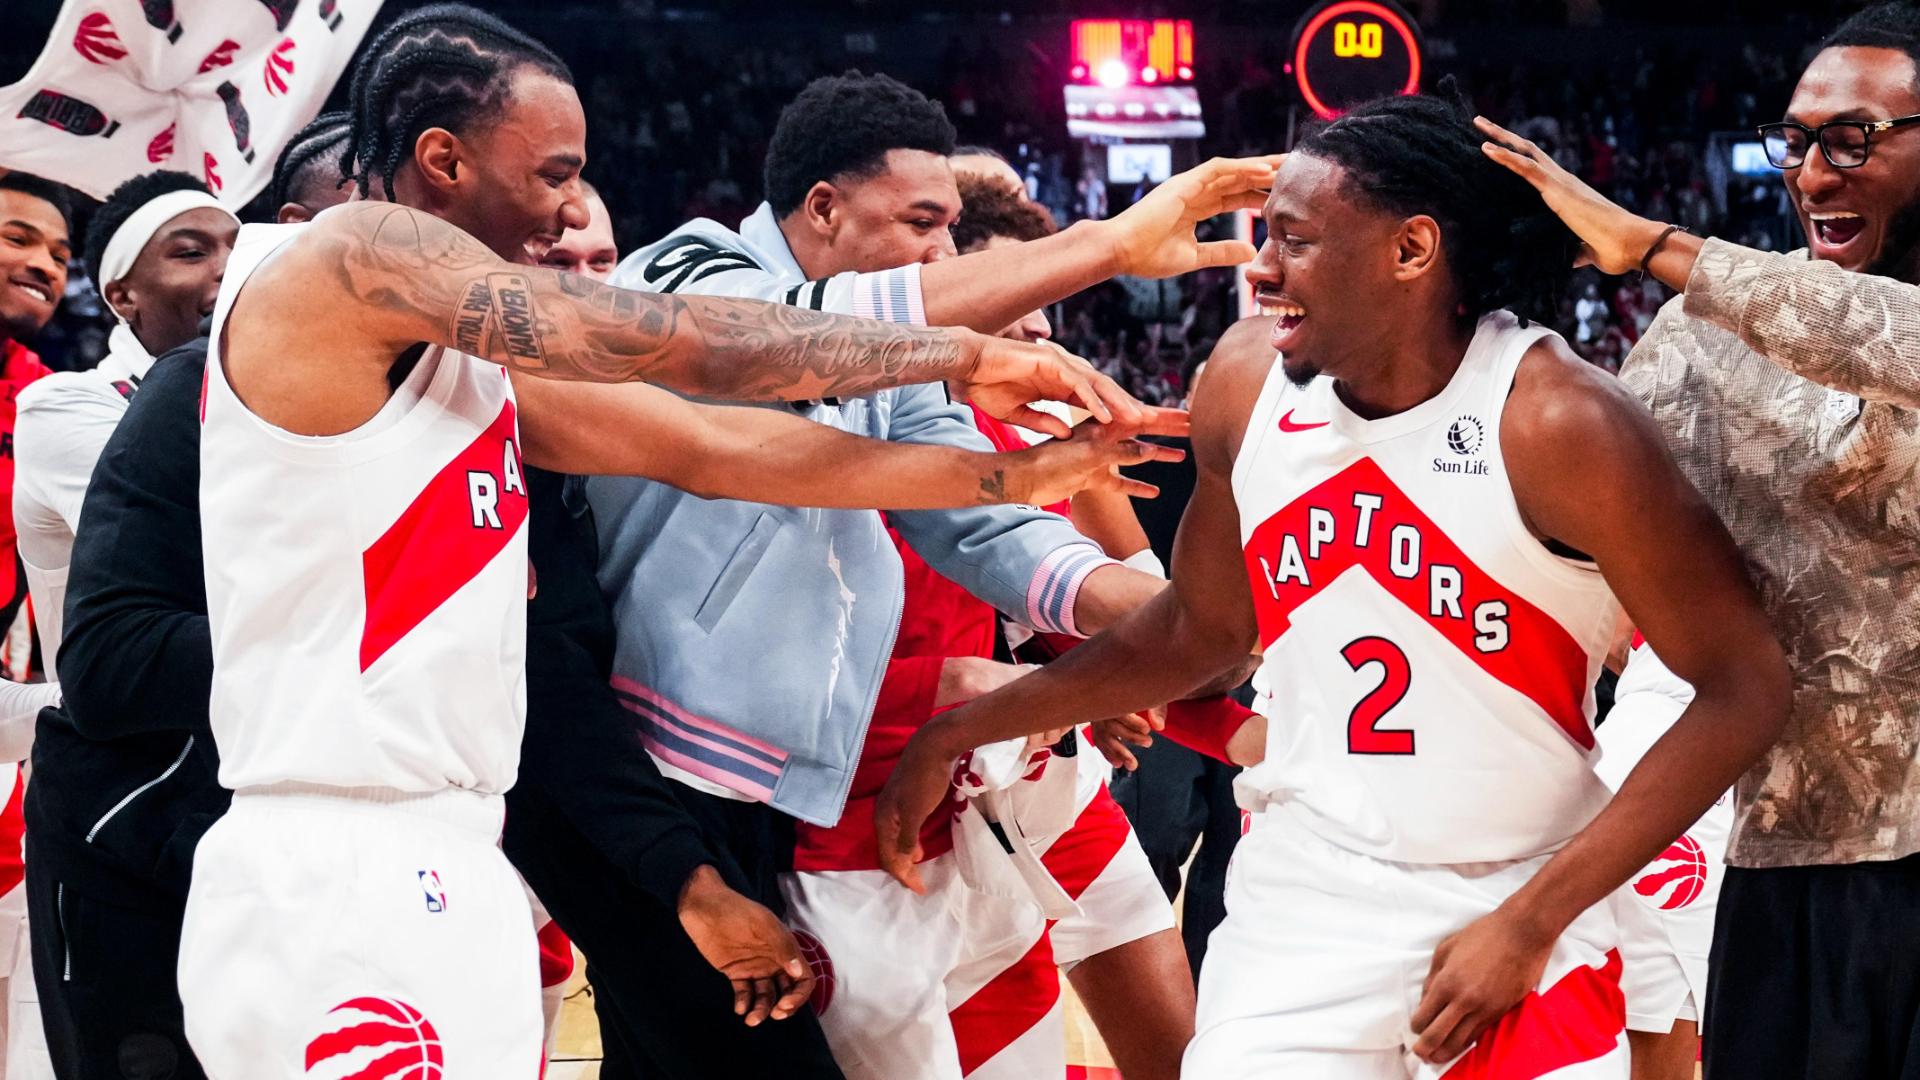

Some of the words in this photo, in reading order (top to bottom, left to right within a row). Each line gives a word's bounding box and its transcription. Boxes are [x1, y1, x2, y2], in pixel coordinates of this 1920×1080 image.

[498, 288, 540, 360] HANOVER
[817, 329, 874, 374] The
[879, 331, 960, 377] Odds
[1432, 457, 1461, 473] Sun
[1463, 460, 1489, 476] Life
[1340, 635, 1416, 756] 2
